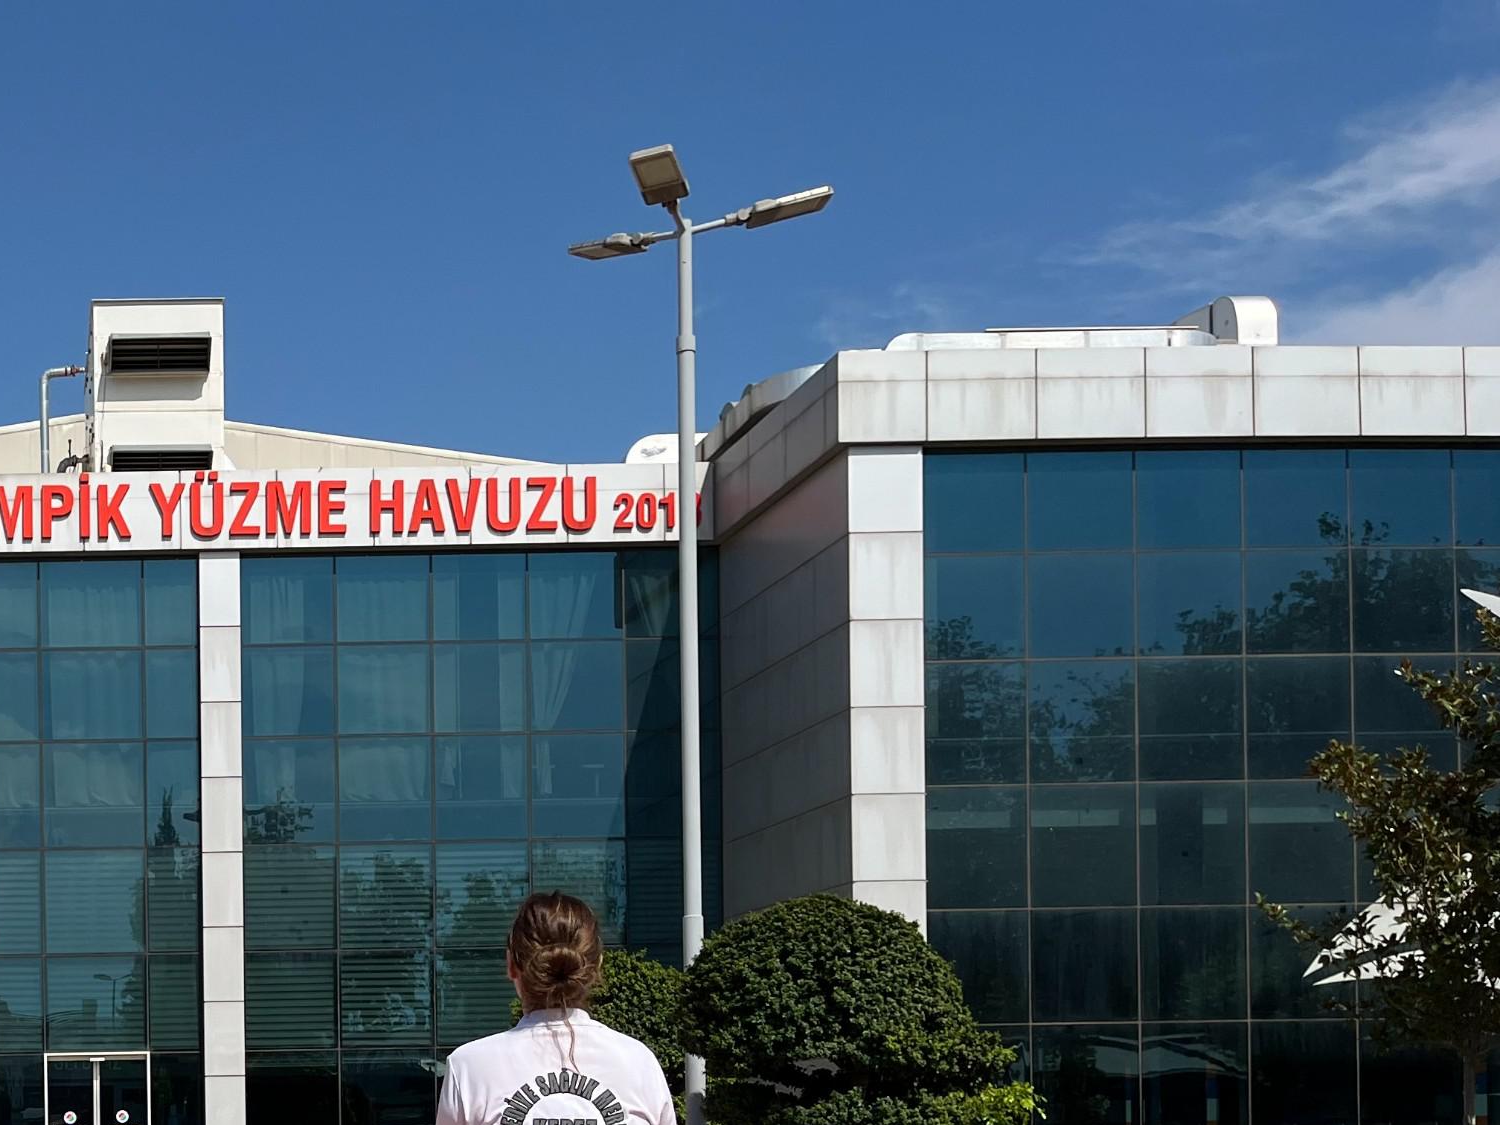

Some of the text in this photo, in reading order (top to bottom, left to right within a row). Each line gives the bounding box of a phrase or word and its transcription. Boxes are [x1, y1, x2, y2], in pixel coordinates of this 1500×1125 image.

[149, 471, 347, 541] YÜZME
[369, 476, 597, 537] HAVUZU
[534, 1068, 600, 1098] SAĞLIK
